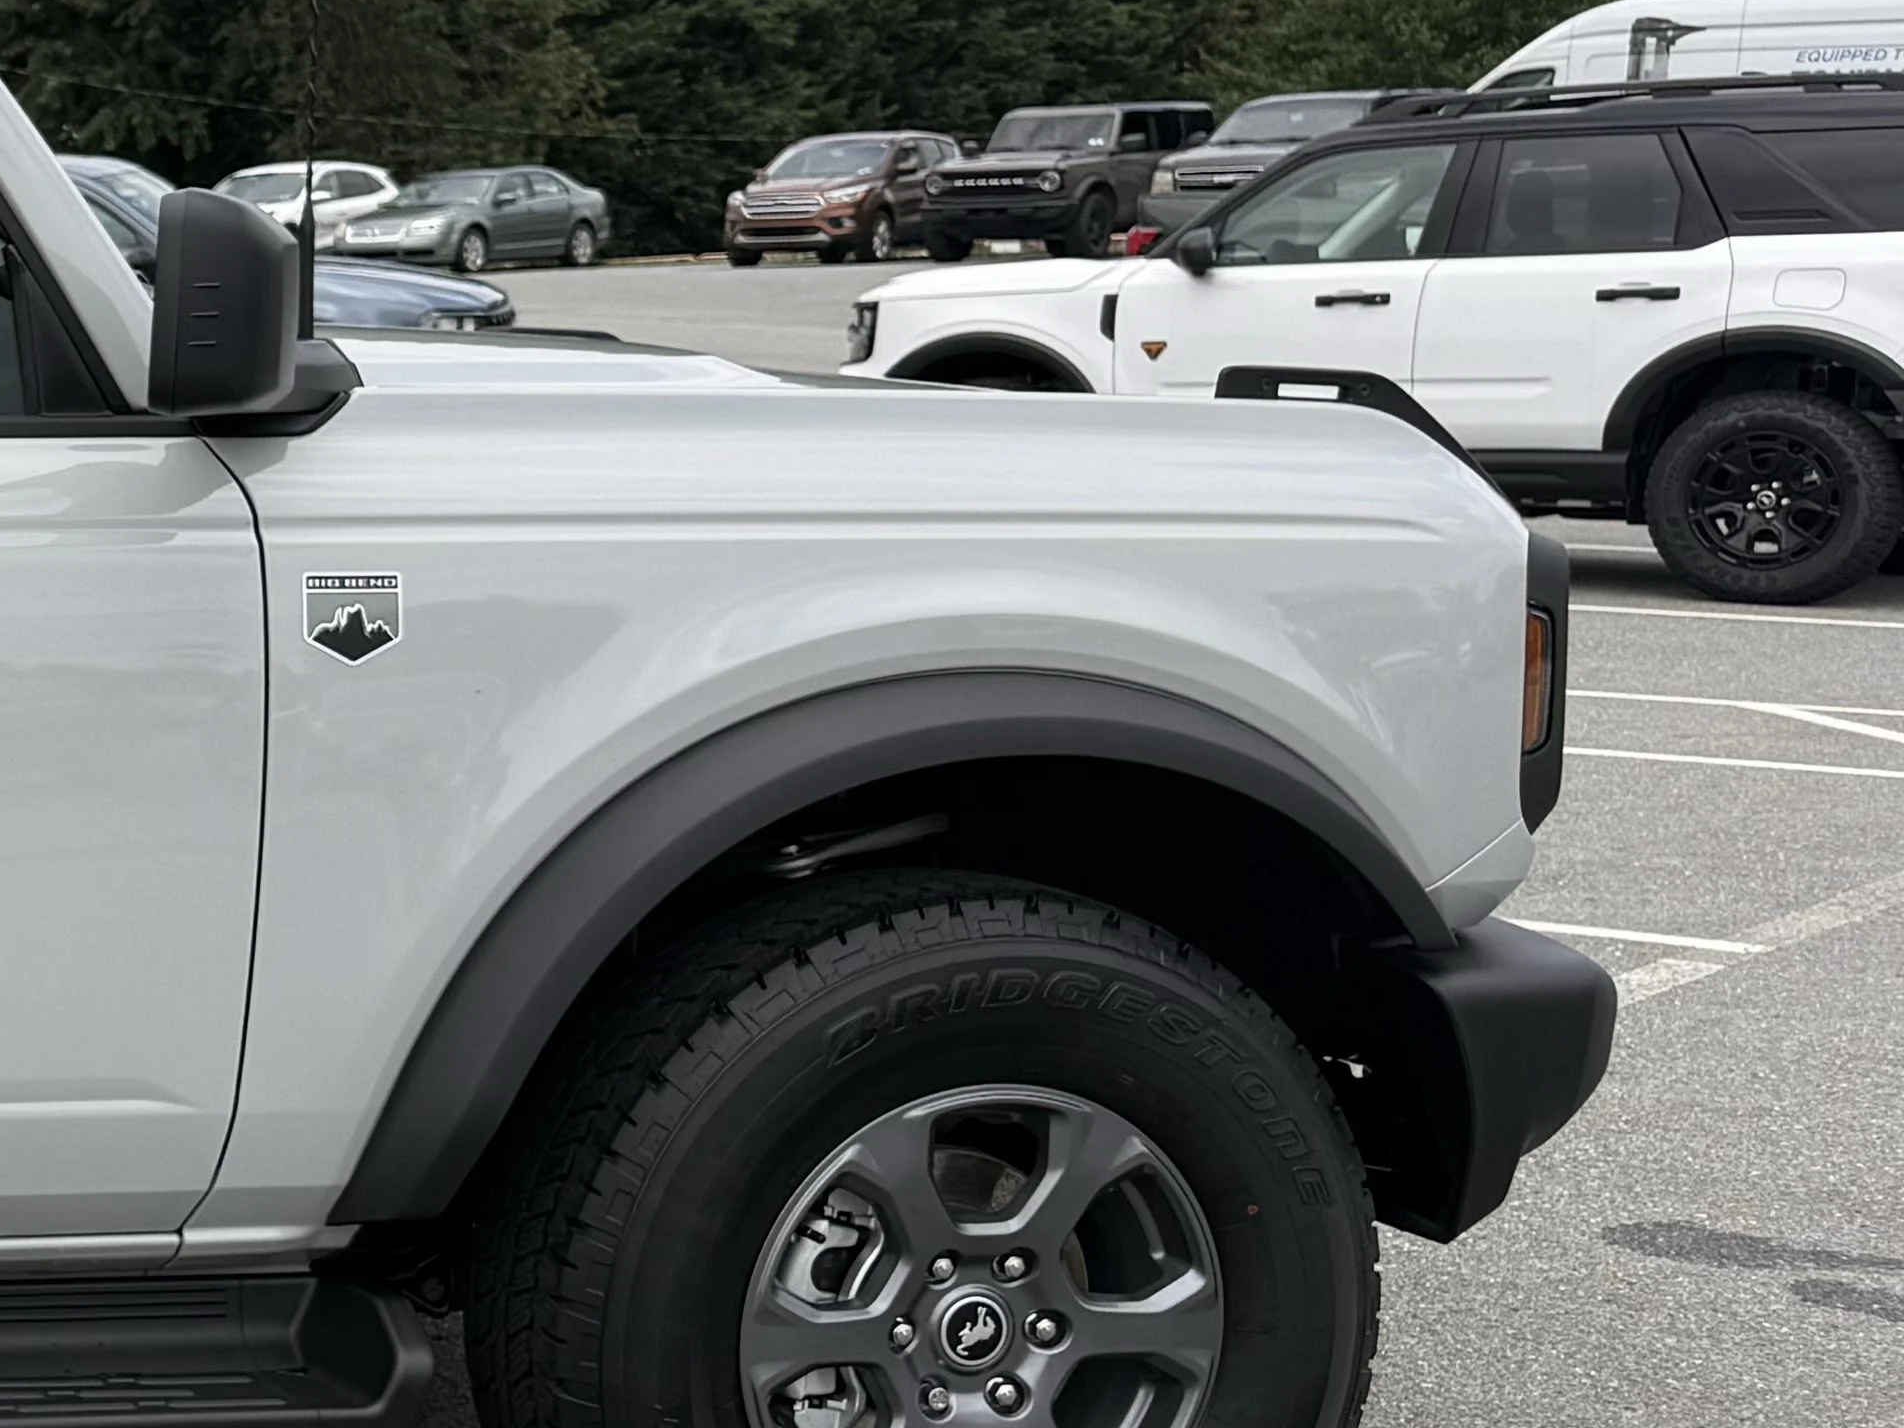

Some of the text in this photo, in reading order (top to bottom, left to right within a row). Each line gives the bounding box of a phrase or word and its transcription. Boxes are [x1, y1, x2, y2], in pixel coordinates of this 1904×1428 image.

[1794, 47, 1904, 63] EQUIPPED T
[307, 578, 396, 588] BIG BEND
[825, 969, 1333, 1208] BRIDGESTONE
